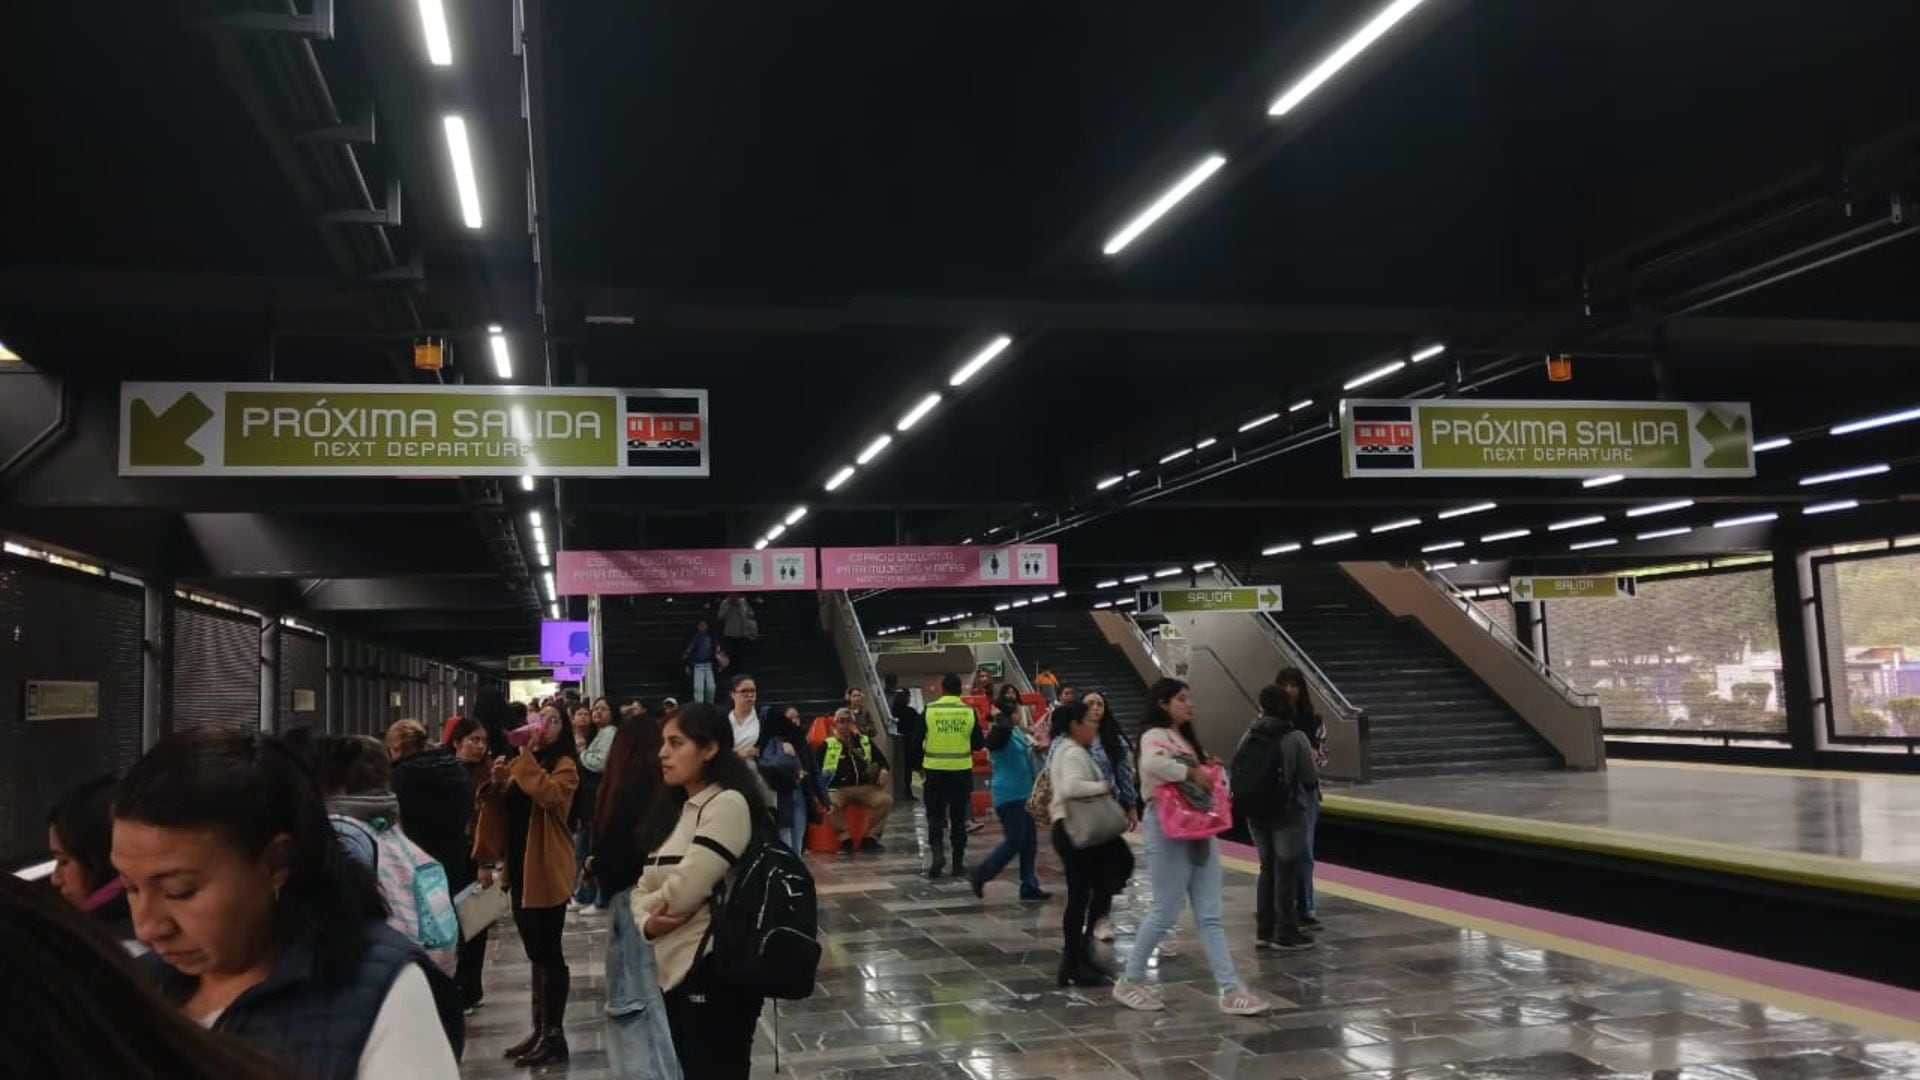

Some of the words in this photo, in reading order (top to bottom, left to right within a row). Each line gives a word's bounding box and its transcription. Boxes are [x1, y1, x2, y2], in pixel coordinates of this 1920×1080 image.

[242, 399, 437, 438] PRÓXIMA
[452, 407, 601, 440] SALIDA
[1431, 413, 1566, 445] PRÓXIMA
[1576, 420, 1679, 445] SALIDA
[313, 441, 376, 457] NEXT
[386, 440, 533, 458] DEPARTURE
[1482, 448, 1526, 462] NEXT
[1534, 448, 1634, 463] DEPARTURE
[1555, 579, 1594, 591] SALIDA
[1187, 591, 1233, 603] SALIDA
